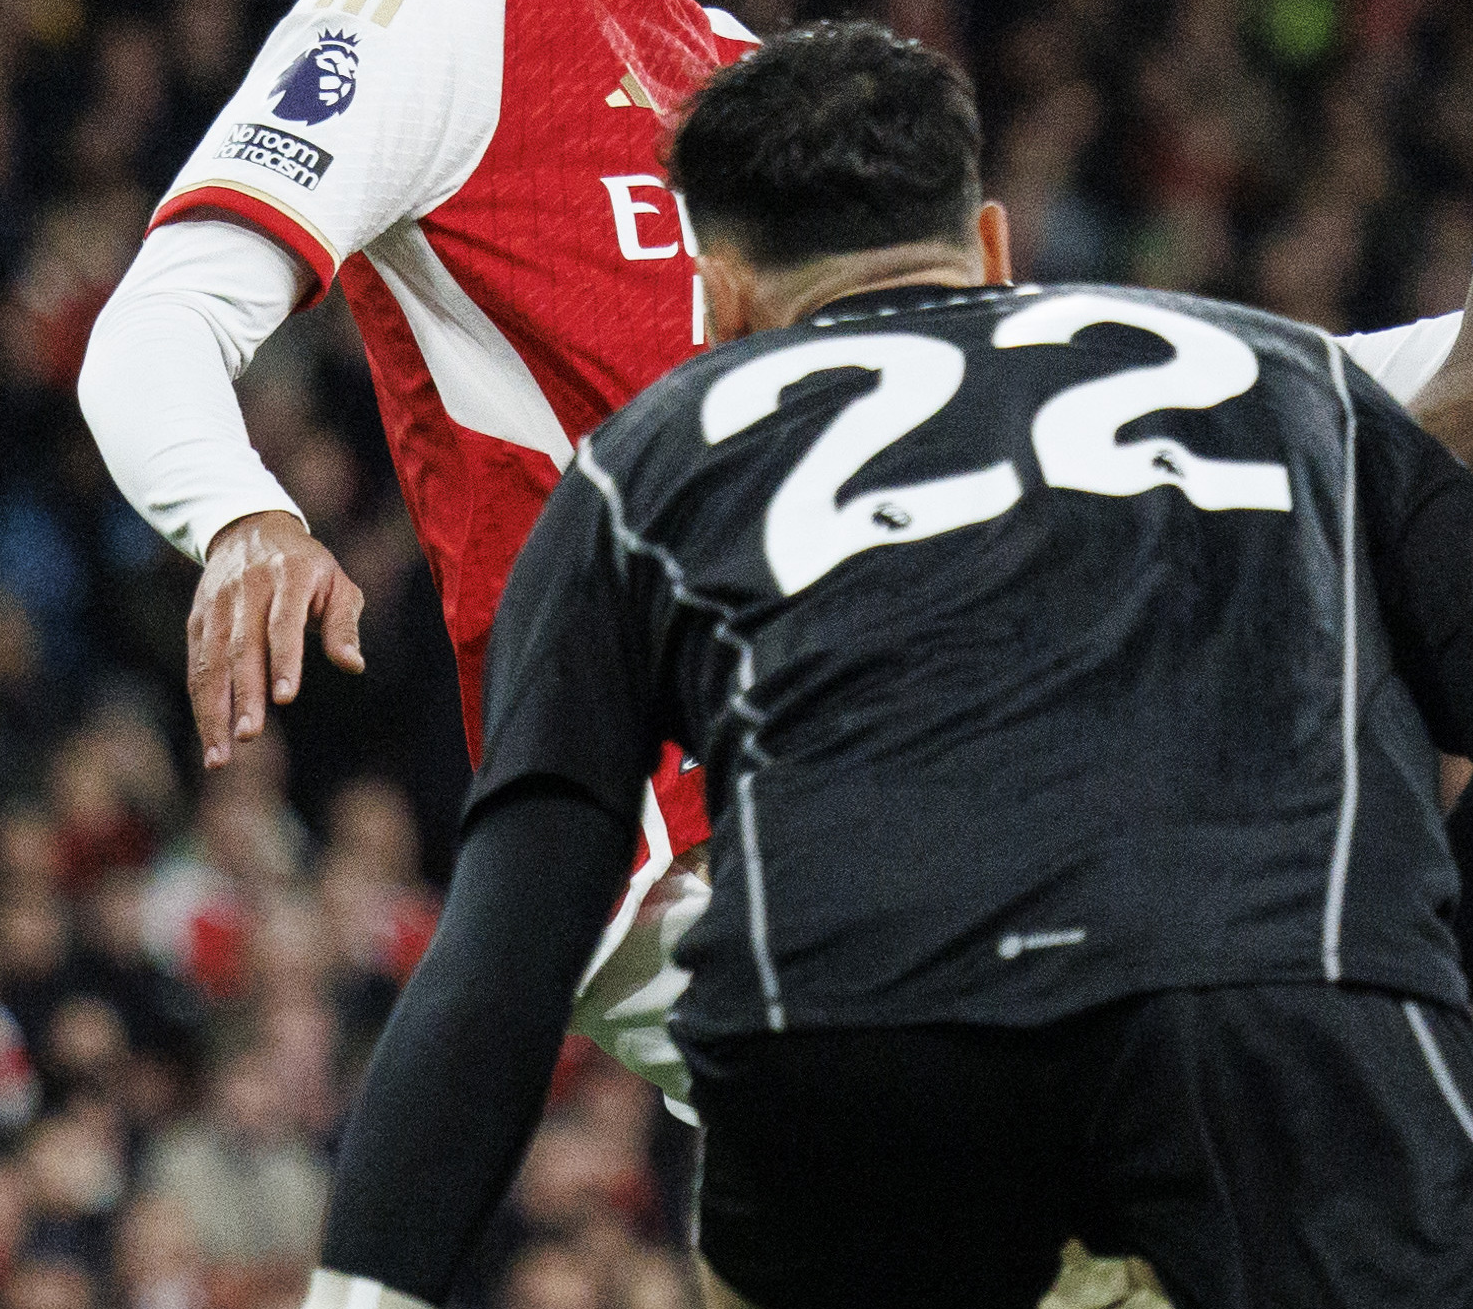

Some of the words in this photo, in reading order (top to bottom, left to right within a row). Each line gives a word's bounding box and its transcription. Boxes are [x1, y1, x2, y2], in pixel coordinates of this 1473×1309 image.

[228, 124, 255, 143] No
[252, 129, 320, 169] room
[241, 144, 320, 191] racism
[701, 293, 1292, 597] 22
